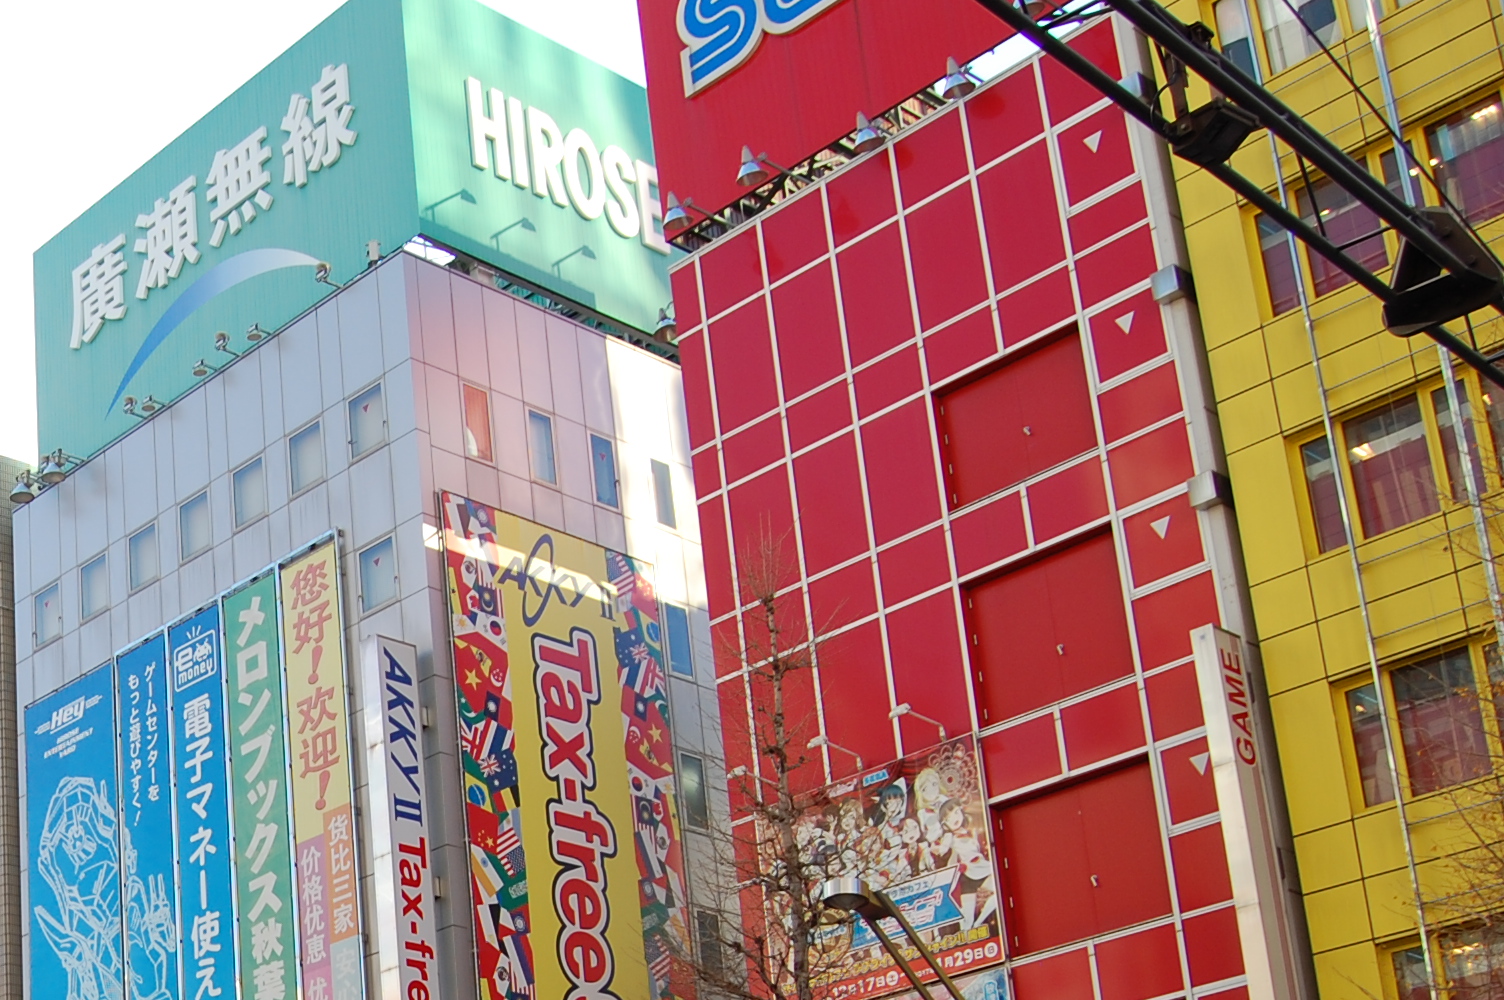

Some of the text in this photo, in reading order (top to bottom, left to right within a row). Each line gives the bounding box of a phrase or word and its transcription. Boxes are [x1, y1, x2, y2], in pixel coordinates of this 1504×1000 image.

[70, 63, 358, 350] 廣瀬無線
[465, 75, 671, 256] HIROSE
[51, 695, 85, 731] Hey
[145, 662, 160, 801] ゲームセンターを
[178, 658, 215, 685] money
[384, 646, 421, 793] AKKY
[1222, 646, 1256, 766] GAME
[327, 812, 356, 934] 货比三家
[533, 628, 616, 990] Tax-free
[300, 844, 326, 964] 价格优惠
